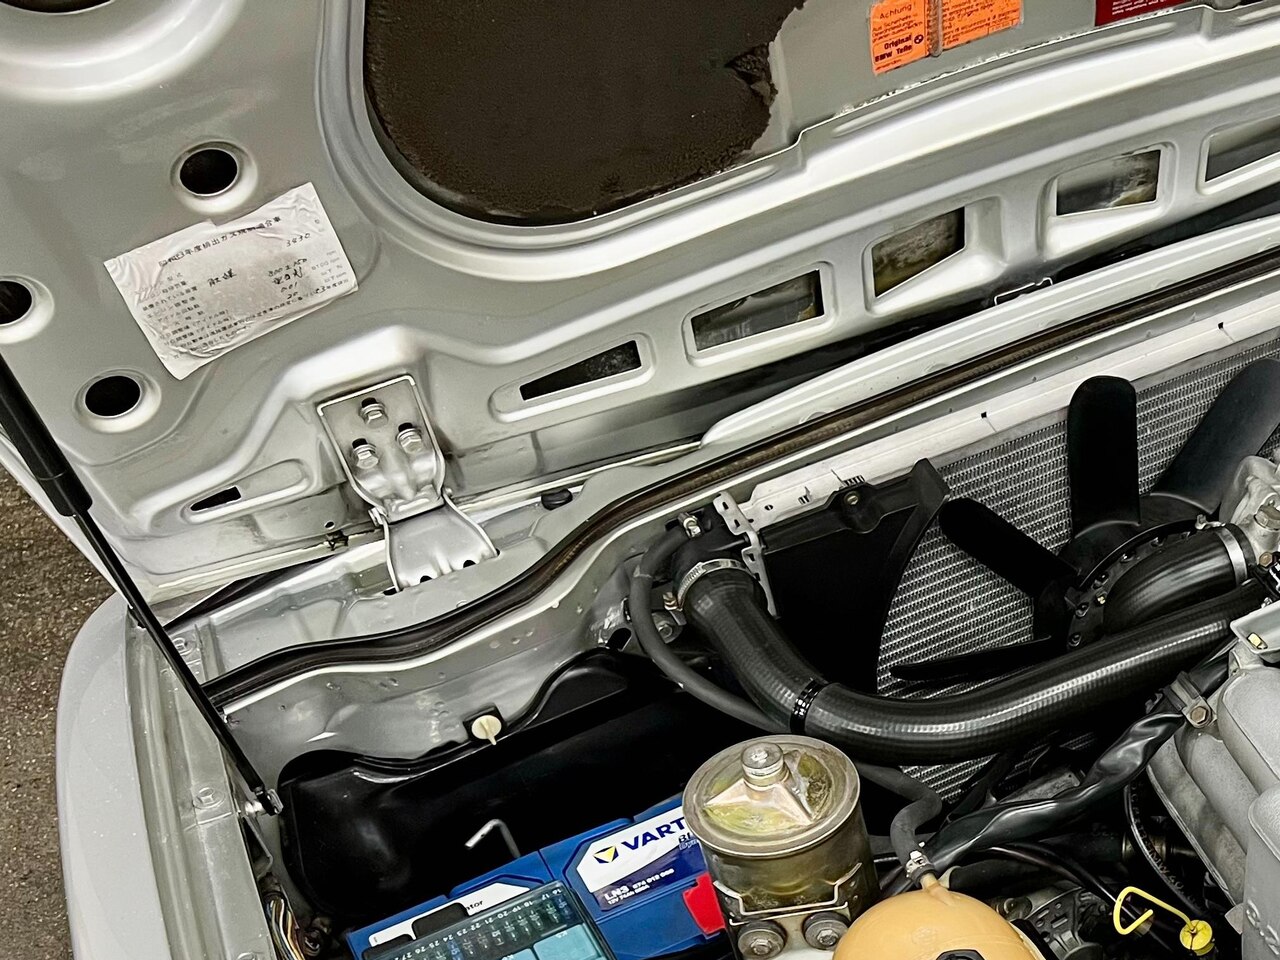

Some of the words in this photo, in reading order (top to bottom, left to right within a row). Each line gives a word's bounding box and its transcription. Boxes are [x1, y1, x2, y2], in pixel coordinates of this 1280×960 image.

[883, 34, 912, 49] Original
[874, 50, 893, 62] BMW
[622, 817, 684, 850] VART
[605, 885, 629, 900] LN3
